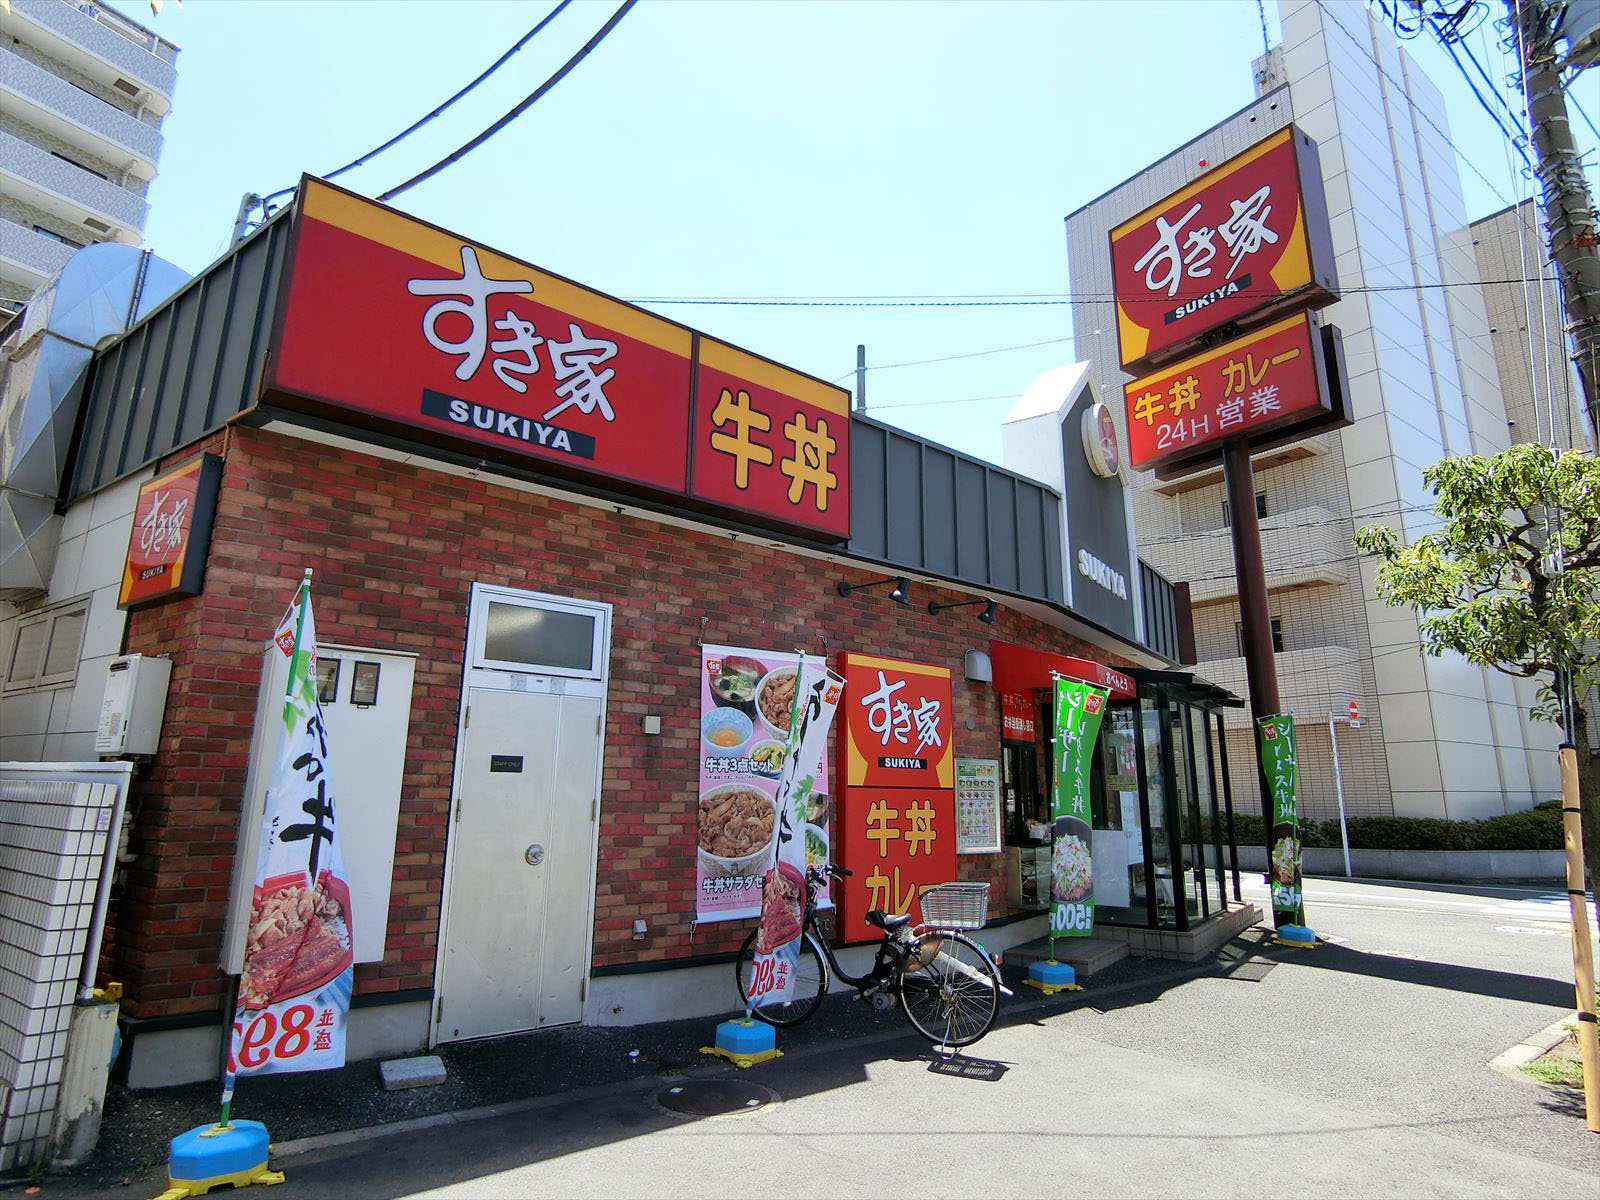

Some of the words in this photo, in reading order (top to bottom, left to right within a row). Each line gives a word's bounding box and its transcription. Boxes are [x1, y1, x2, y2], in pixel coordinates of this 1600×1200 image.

[1134, 185, 1279, 296] すき家
[1175, 283, 1239, 318] SUKIYA
[406, 245, 618, 422] すき家
[1134, 376, 1200, 426] 牛丼
[1222, 348, 1300, 397] カレー
[448, 400, 572, 452] SUKIYA
[709, 388, 838, 512] 牛丼
[141, 491, 189, 561] すき家
[142, 565, 165, 579] SUKIYA
[1078, 549, 1128, 600] SUKIYA
[862, 670, 942, 755] すき家
[705, 757, 775, 773] 牛丼3点セット
[884, 757, 921, 769] SUKIYA
[866, 800, 937, 857] 牛丼
[865, 864, 945, 926] カレ
